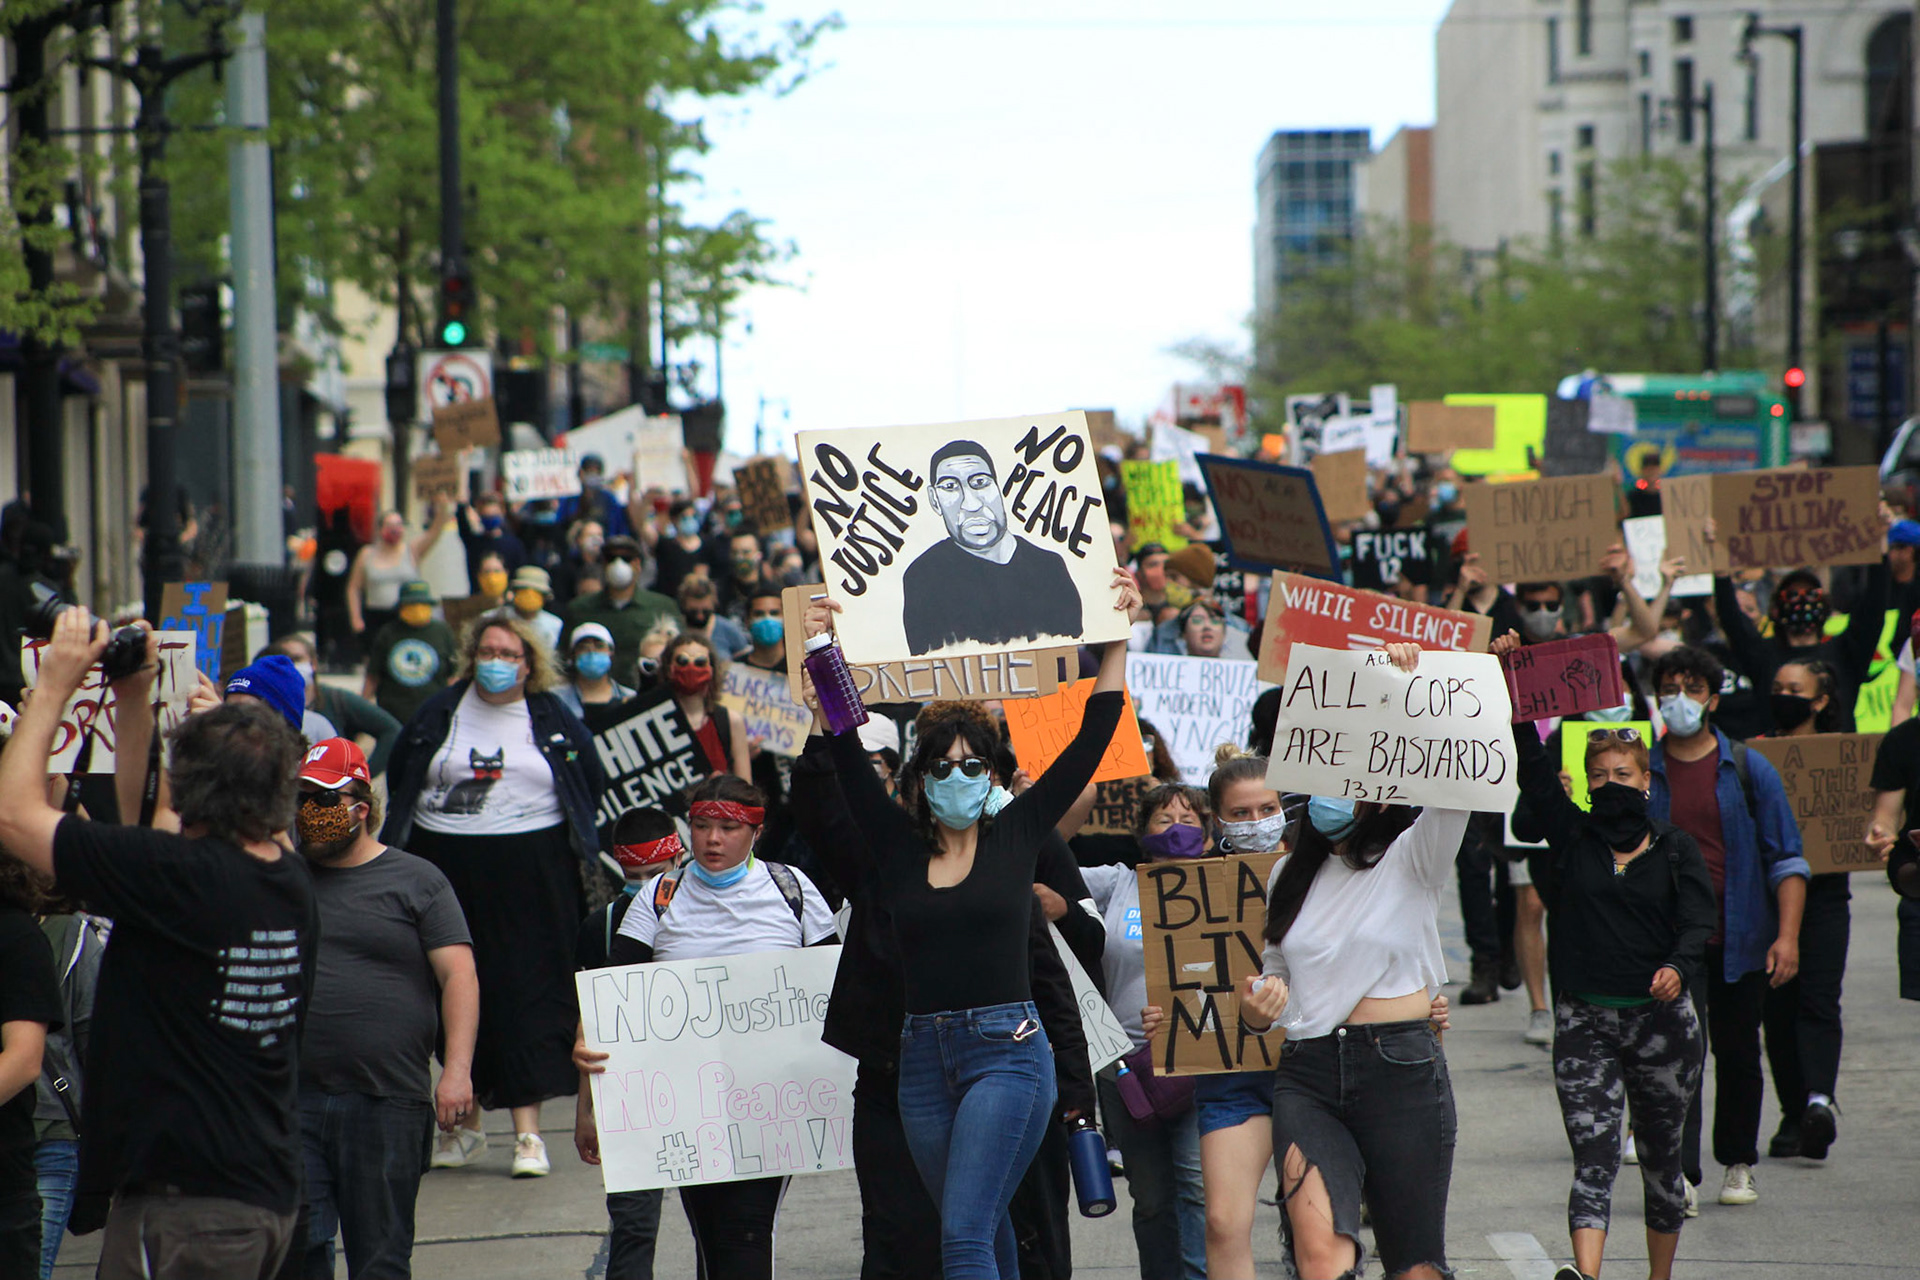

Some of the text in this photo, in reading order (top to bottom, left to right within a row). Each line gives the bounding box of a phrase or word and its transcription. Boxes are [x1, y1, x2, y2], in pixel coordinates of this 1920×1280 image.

[1013, 425, 1085, 474] NO
[811, 442, 859, 538] NO
[1493, 482, 1594, 527] ENOUGH
[1750, 471, 1833, 503] STOP
[830, 442, 924, 597] JUSTICE
[1002, 462, 1102, 559] PEACE
[1738, 498, 1850, 534] KILLING
[1355, 531, 1427, 562] FUCK
[1496, 536, 1591, 580] ENOUGH
[1728, 530, 1804, 568] BLACK
[1379, 556, 1401, 584] 12
[1280, 581, 1467, 652] WHITE SILENCE
[720, 670, 775, 702] BLACK
[1131, 659, 1187, 691] POLICE
[1286, 665, 1482, 718] ALL COPS
[1156, 692, 1222, 718] MODERN
[1283, 727, 1507, 785] ARE BASTARDS
[1809, 766, 1858, 793] THE
[1822, 816, 1865, 842] THE
[592, 967, 689, 1044] NO
[597, 1060, 838, 1133] NO Peace
